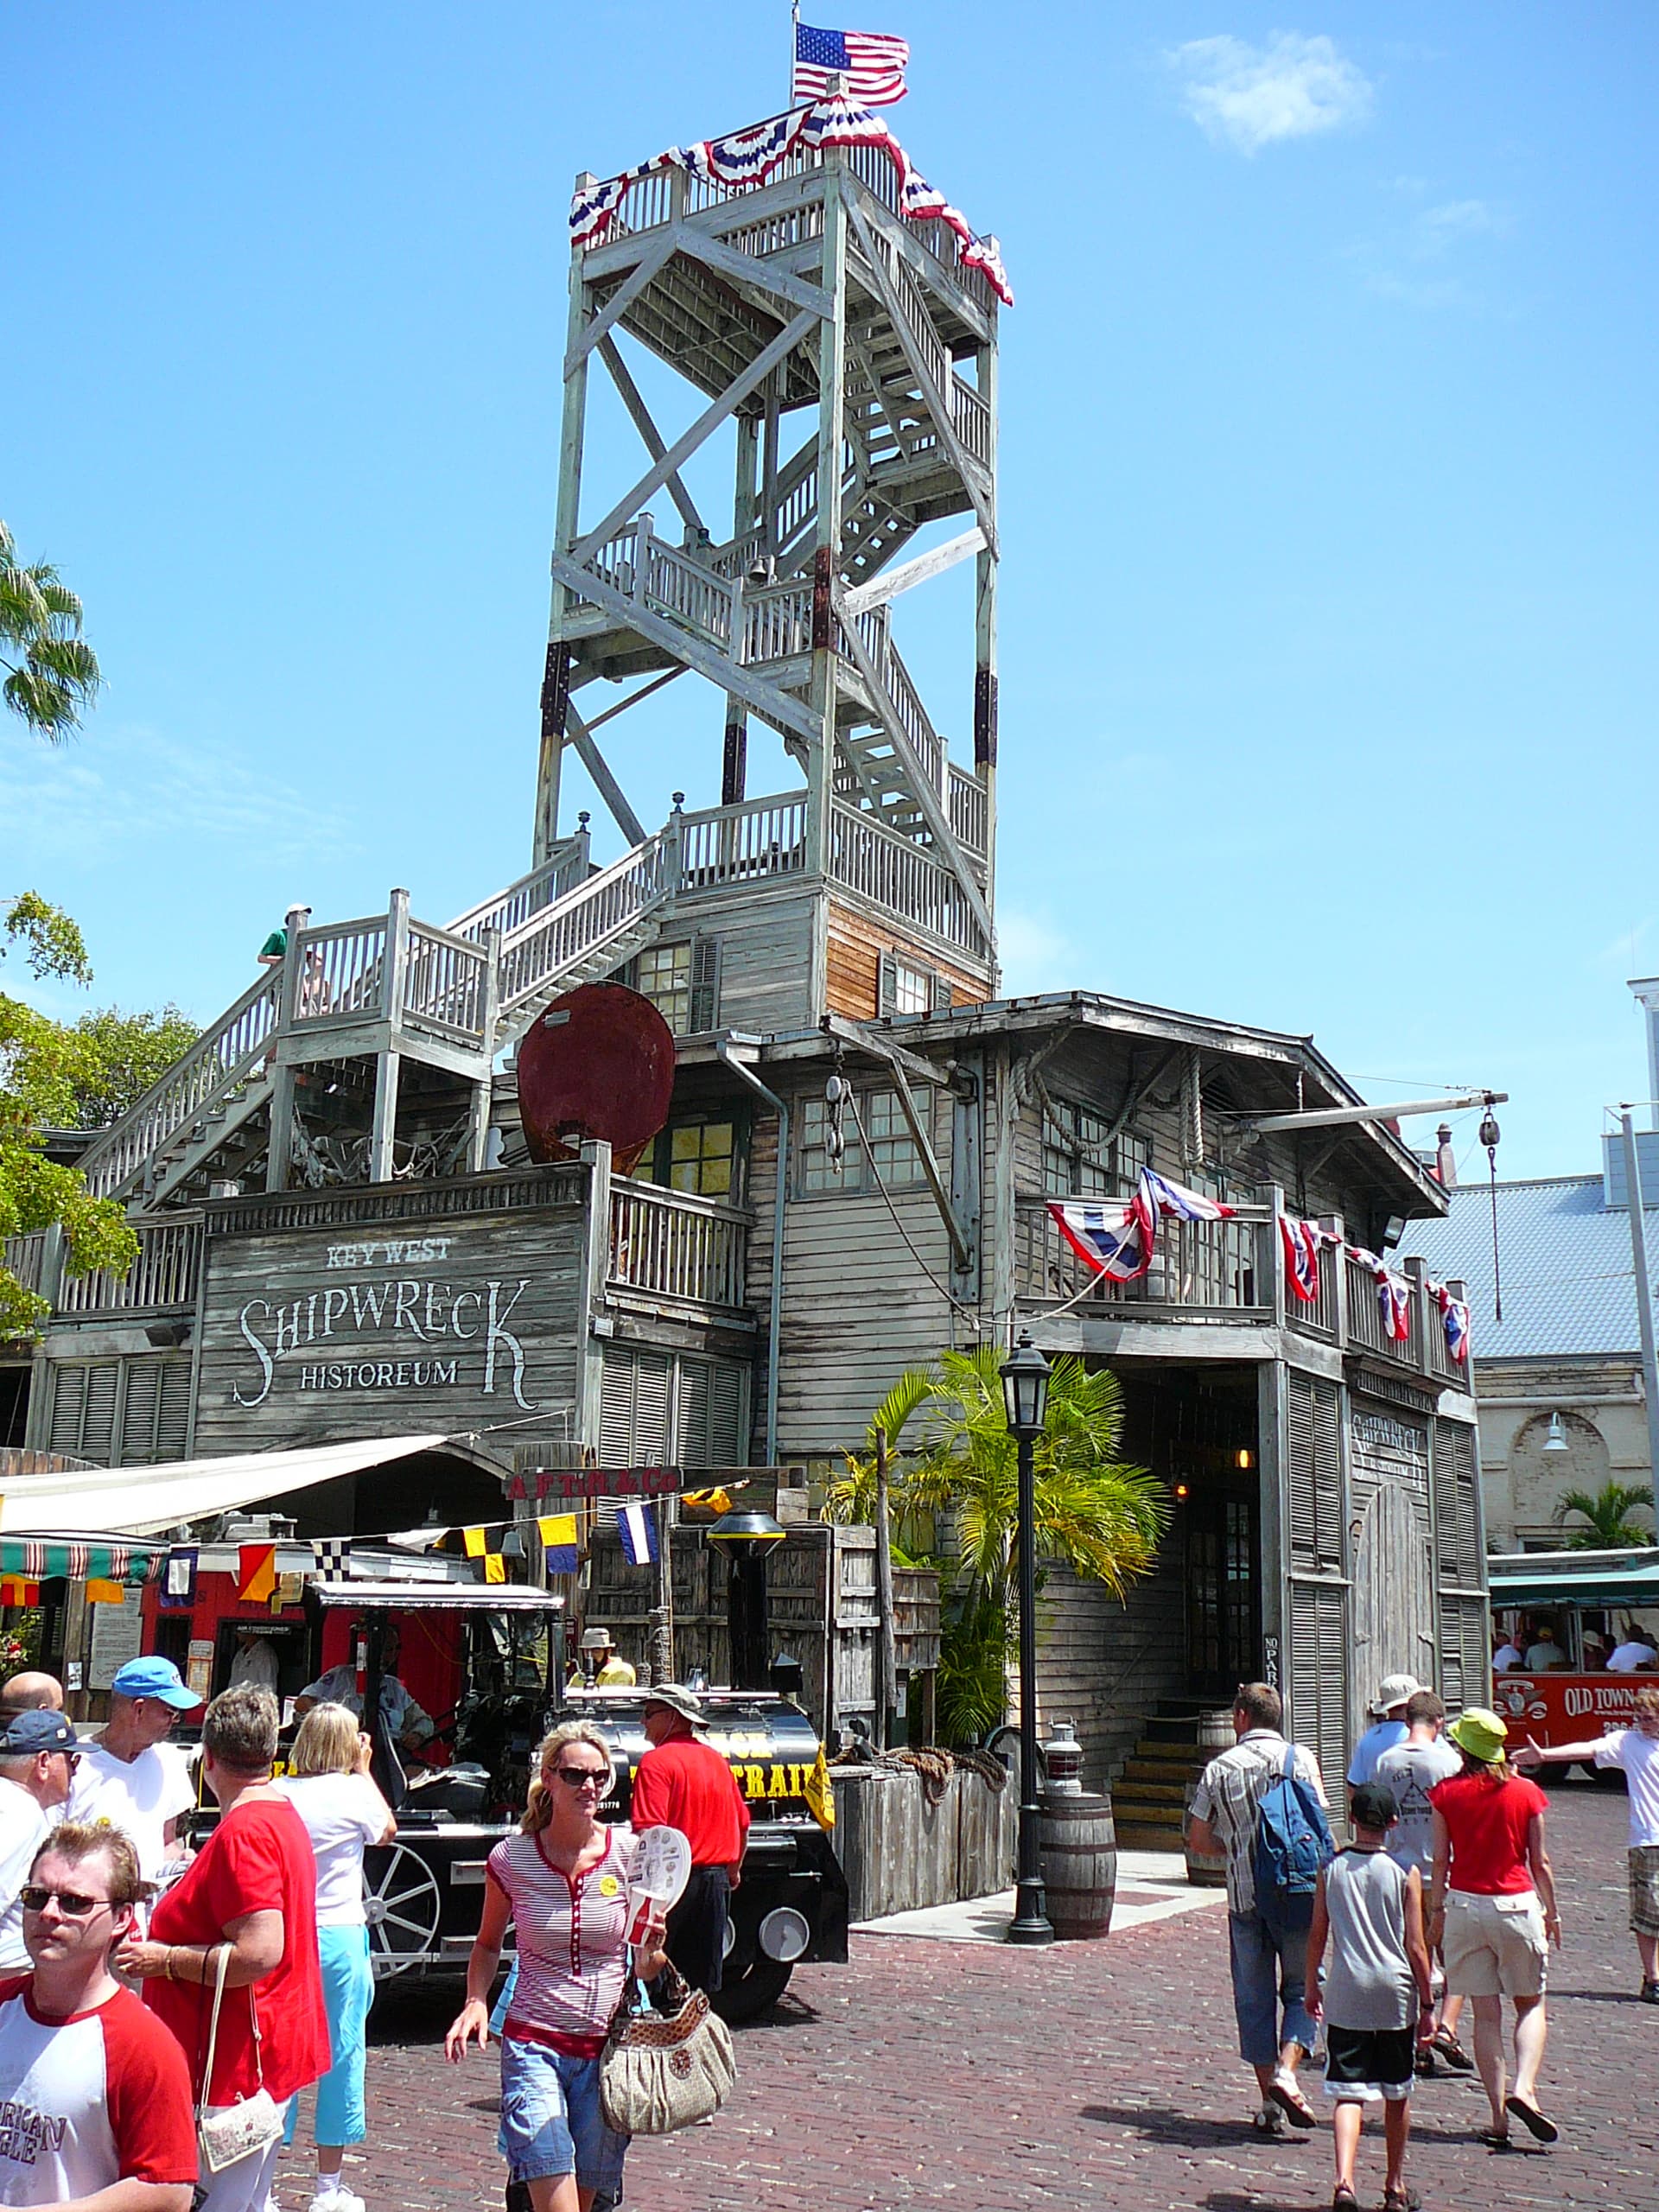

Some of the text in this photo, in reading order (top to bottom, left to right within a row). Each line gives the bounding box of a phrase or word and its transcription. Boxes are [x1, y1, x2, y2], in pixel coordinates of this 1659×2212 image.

[326, 1237, 452, 1268] KEY WEST
[232, 1279, 540, 1411] SHIPWRECK
[300, 1360, 460, 1390] HISTOREUM
[1351, 1414, 1425, 1497] SHIPWRECK
[508, 1475, 527, 1500] A
[641, 1466, 679, 1494] Co
[1265, 1637, 1279, 1649] NO
[1565, 1687, 1593, 1717] OLD
[1594, 1688, 1635, 1709] TOWN
[0, 2102, 67, 2152] RICAN
